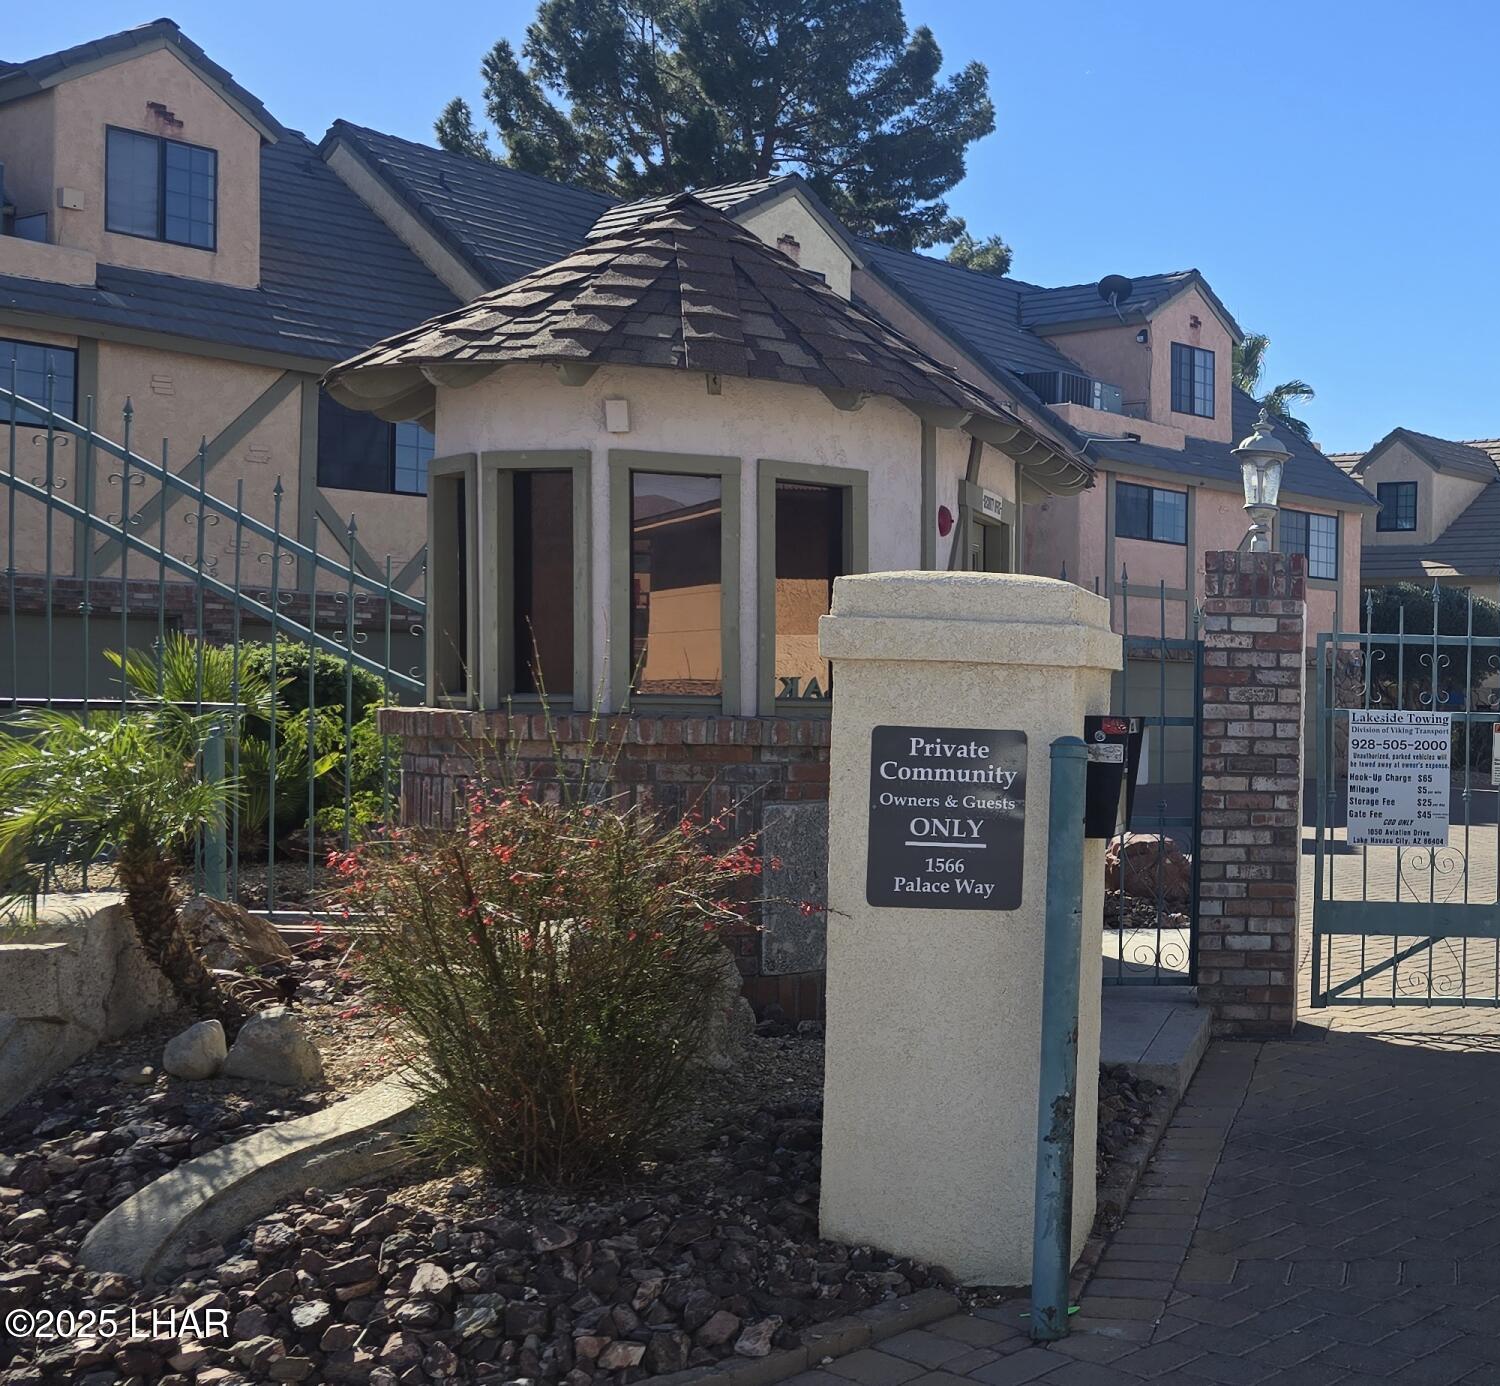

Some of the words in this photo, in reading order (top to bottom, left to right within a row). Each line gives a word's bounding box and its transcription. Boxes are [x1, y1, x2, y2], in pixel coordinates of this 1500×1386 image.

[1351, 712, 1404, 723] Lakeside
[1407, 713, 1449, 726] Towing
[1390, 727, 1413, 735] Viking
[1414, 728, 1449, 736] Transport
[909, 737, 990, 759] Private
[1351, 738, 1448, 751] 928-505-2000
[1392, 753, 1411, 761] parked
[1413, 753, 1435, 761] vehicles
[880, 761, 1018, 790] Community
[1349, 773, 1382, 782] Hook-Up
[1385, 773, 1412, 783] Charge
[1417, 774, 1433, 783] $65
[1349, 785, 1379, 794] Mileage
[1417, 786, 1428, 794] $5
[880, 792, 940, 808] Owners
[945, 795, 958, 808] &
[962, 795, 1016, 810] Guests
[1349, 797, 1379, 806] Storage
[1382, 797, 1396, 806] Fee
[1417, 798, 1432, 807] $25
[1349, 810, 1367, 818] Gate
[1369, 810, 1383, 818] Fee
[1417, 811, 1432, 819] $45
[910, 817, 984, 838] ONLY
[925, 858, 965, 873] 1566
[894, 877, 950, 894] Palace
[955, 879, 995, 899] Way
